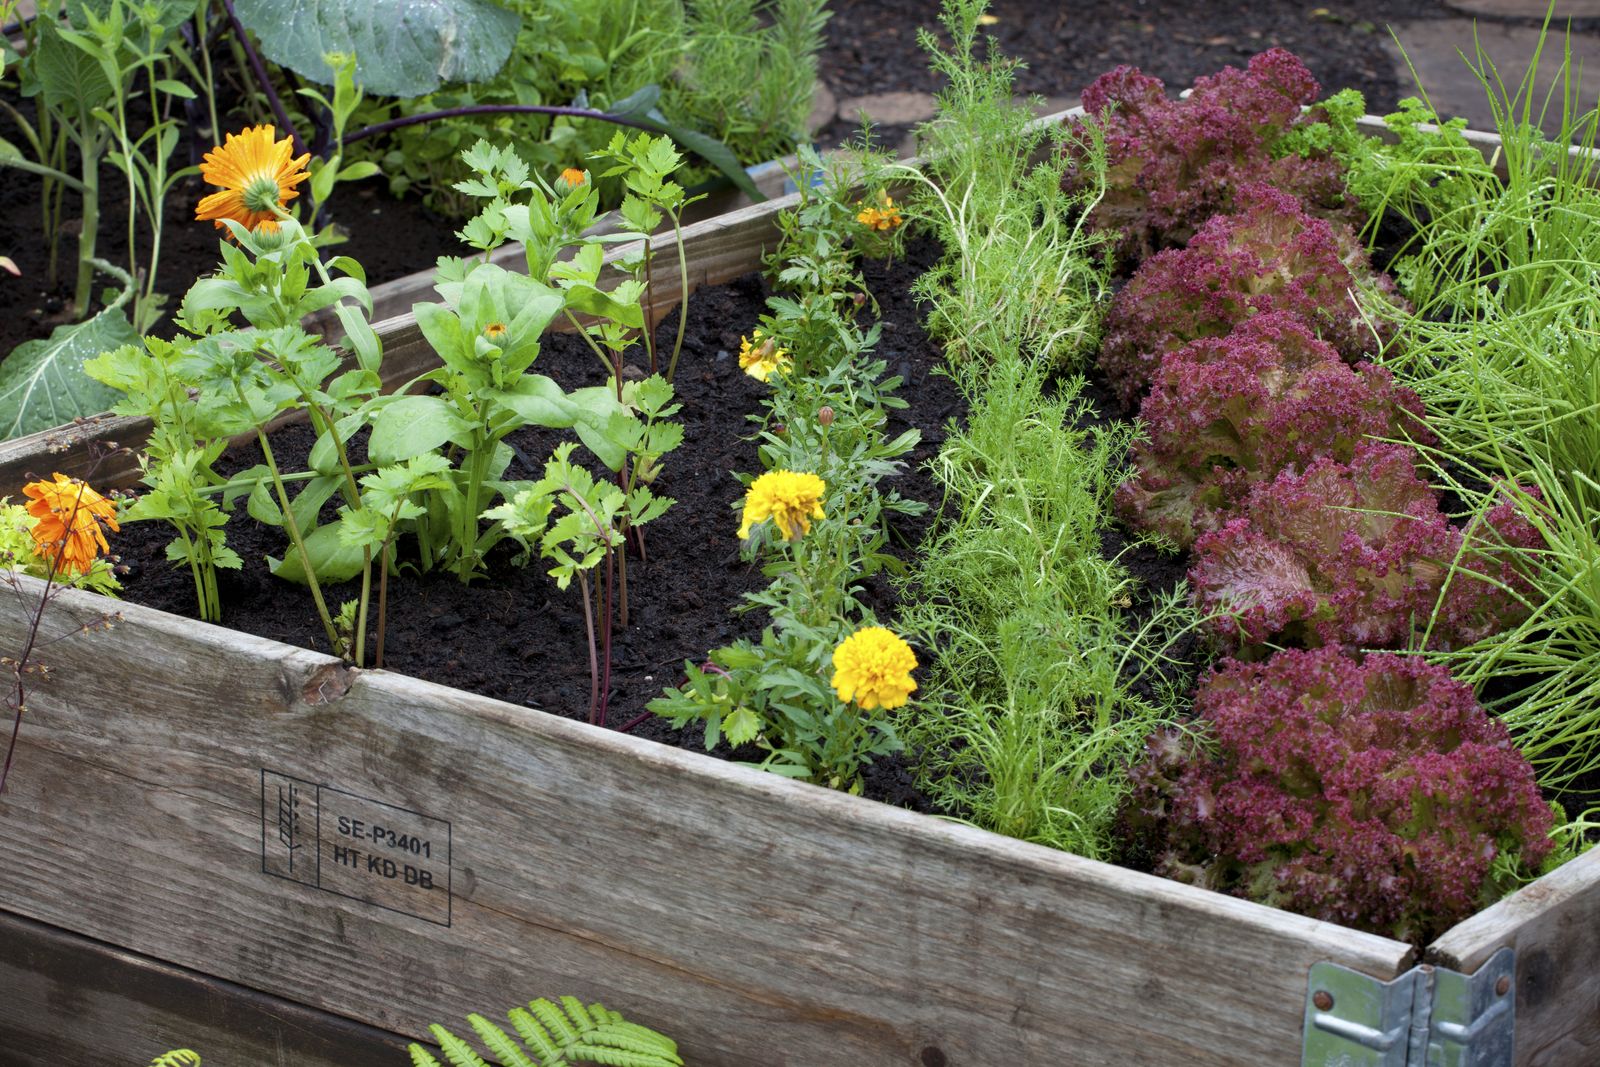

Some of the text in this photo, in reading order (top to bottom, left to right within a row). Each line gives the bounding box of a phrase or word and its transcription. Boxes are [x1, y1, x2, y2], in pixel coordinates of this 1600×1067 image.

[338, 816, 431, 858] SE-P3401
[334, 845, 434, 890] HT KD DB
